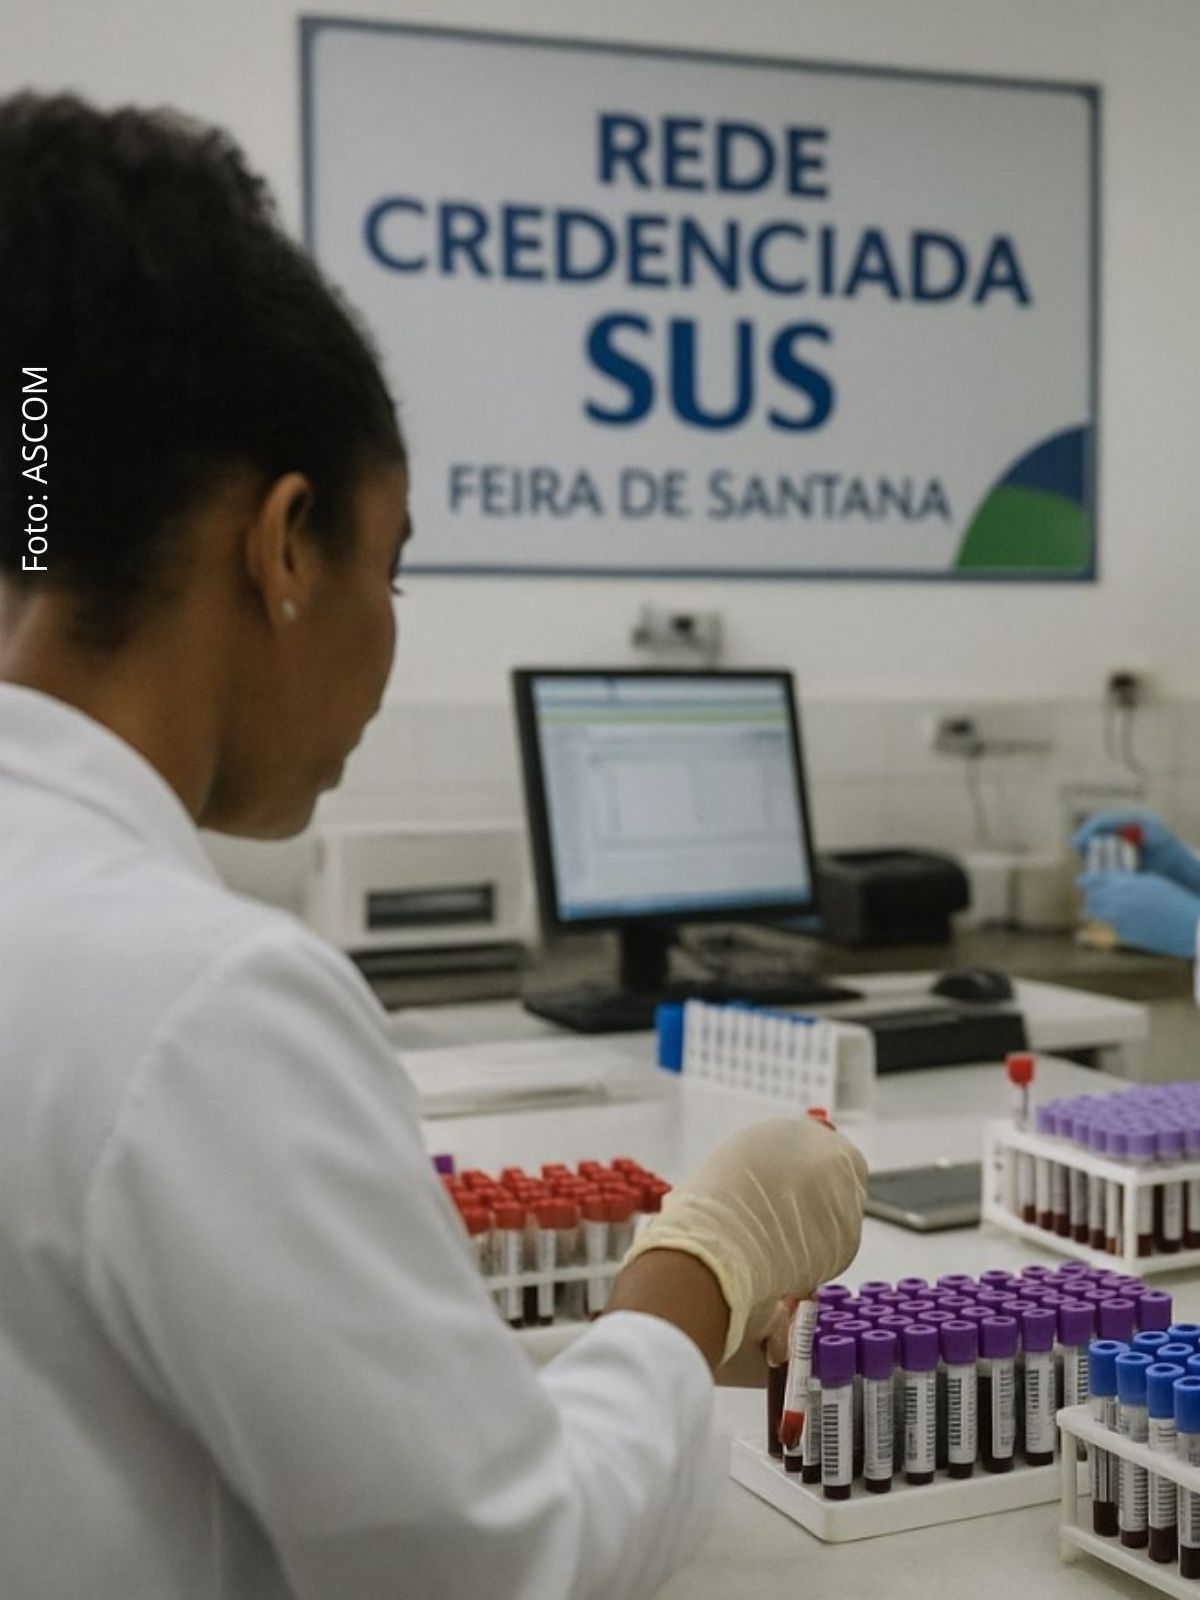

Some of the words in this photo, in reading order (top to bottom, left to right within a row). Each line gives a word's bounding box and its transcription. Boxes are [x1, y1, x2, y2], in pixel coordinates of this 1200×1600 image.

[598, 112, 830, 198] REDE
[363, 197, 1033, 308] CREDENCIADA
[583, 311, 838, 434] SUS
[448, 463, 606, 518] FEIRA
[619, 467, 685, 518] DE
[707, 468, 953, 524] SANTANA
